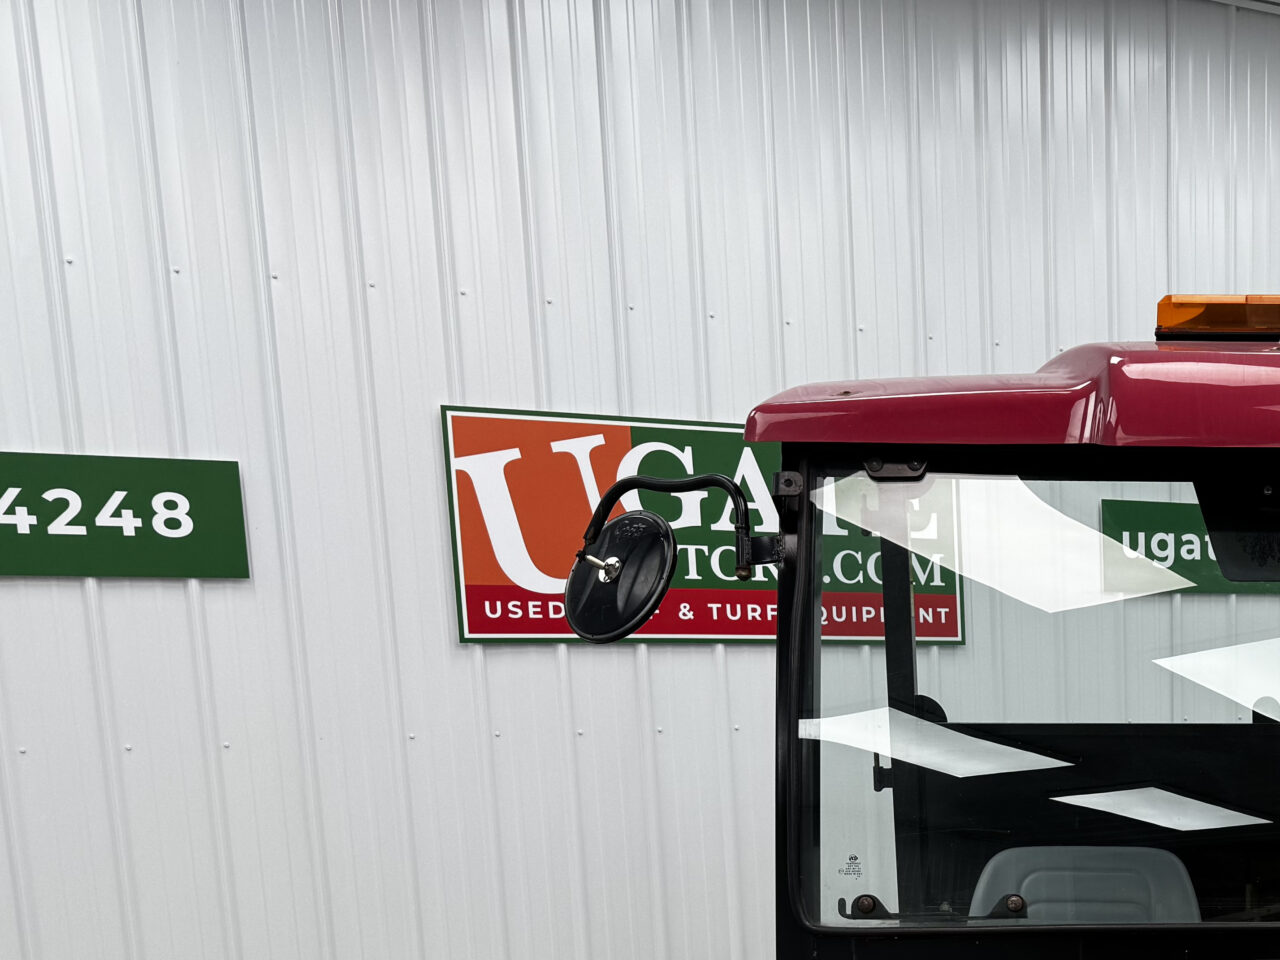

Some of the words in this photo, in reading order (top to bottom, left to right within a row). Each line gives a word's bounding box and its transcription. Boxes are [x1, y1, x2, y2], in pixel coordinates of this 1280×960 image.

[0, 487, 194, 538] 4248
[484, 600, 566, 619] USED
[678, 603, 694, 620] &
[707, 603, 778, 621] TURF
